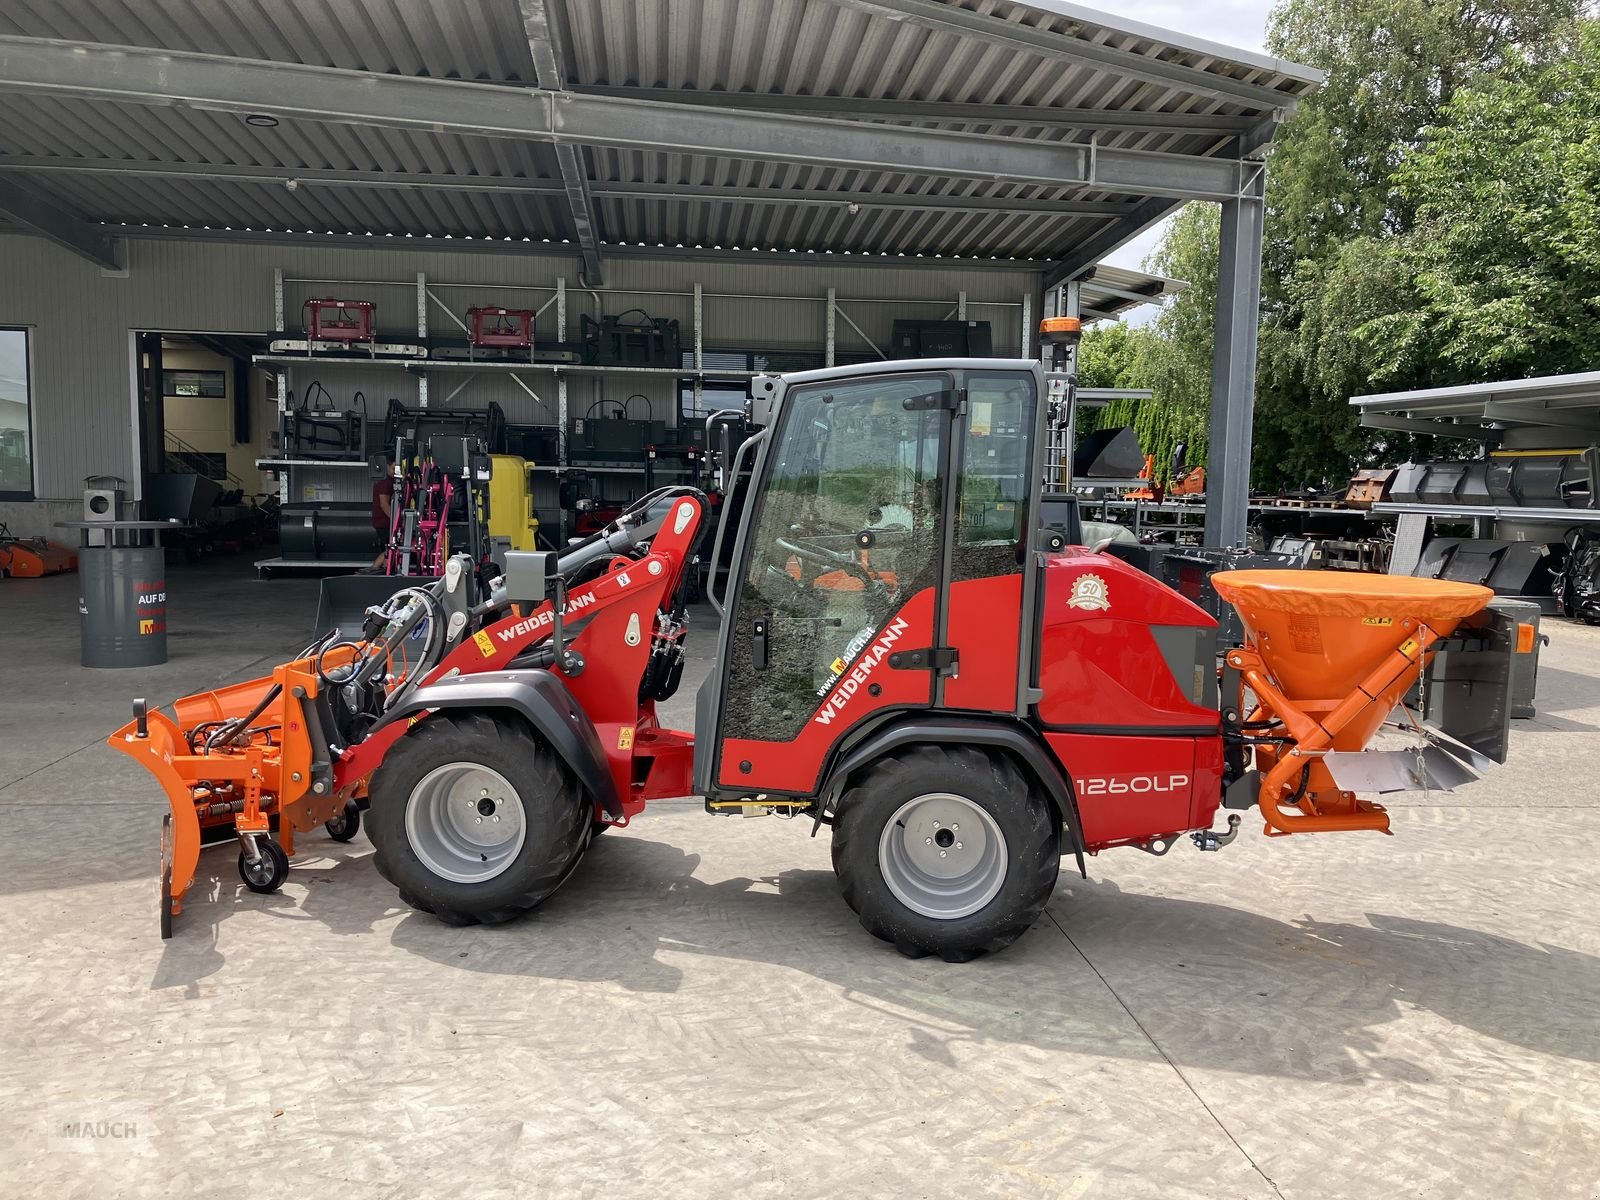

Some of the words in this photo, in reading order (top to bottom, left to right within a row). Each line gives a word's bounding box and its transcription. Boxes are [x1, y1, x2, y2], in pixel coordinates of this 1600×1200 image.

[1081, 582, 1098, 595] 50
[138, 594, 158, 605] AUF
[814, 616, 909, 725] WEIDEMANN
[816, 626, 876, 697] www.MAUCH.at
[1076, 775, 1188, 795] 1260LP
